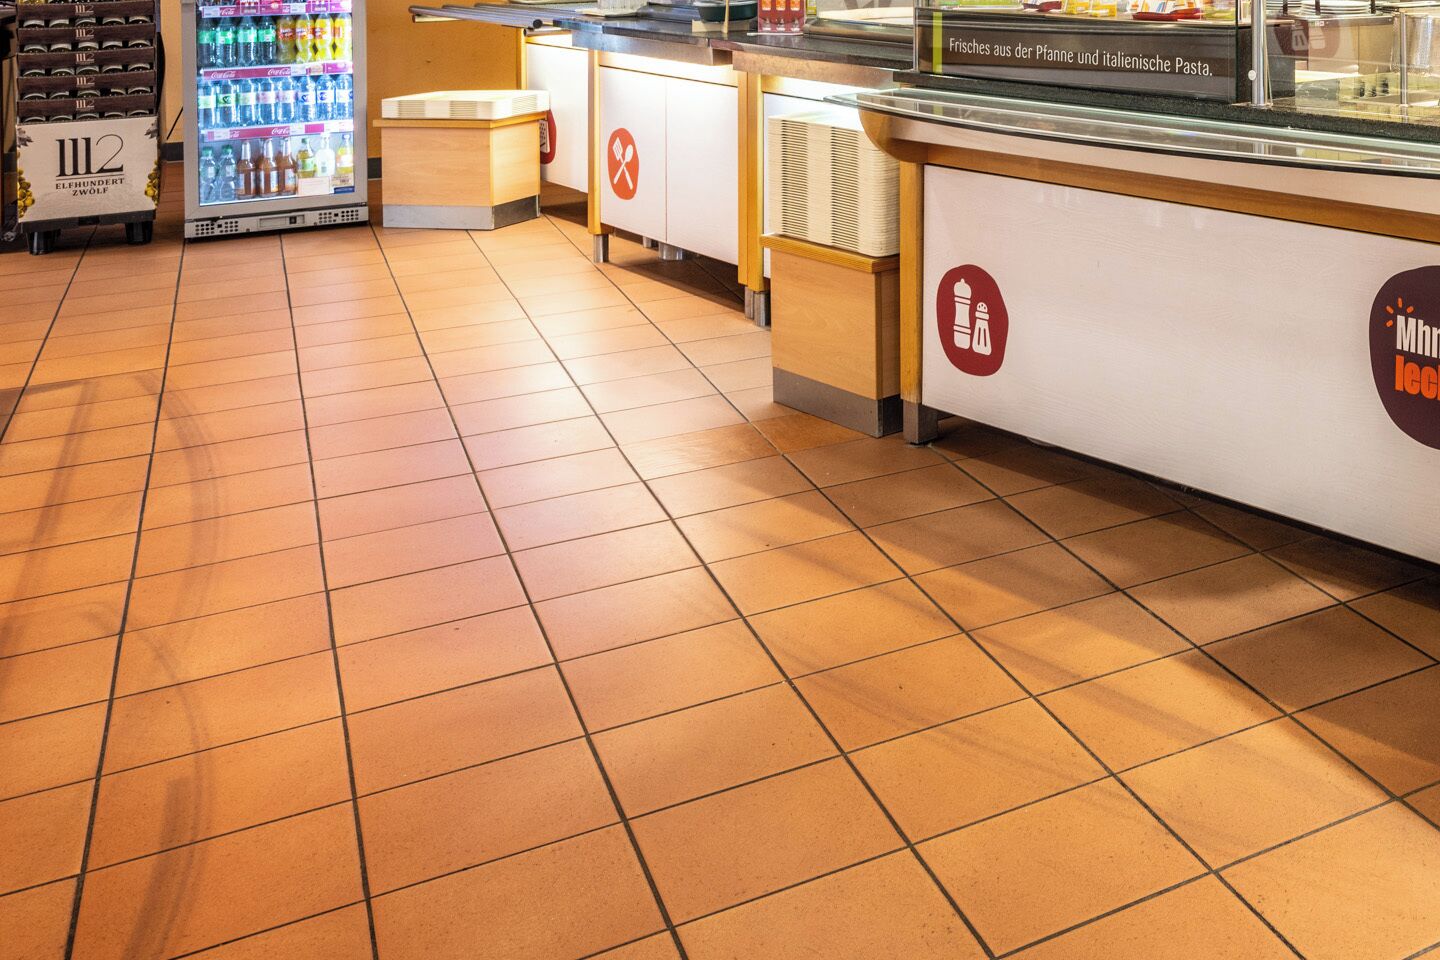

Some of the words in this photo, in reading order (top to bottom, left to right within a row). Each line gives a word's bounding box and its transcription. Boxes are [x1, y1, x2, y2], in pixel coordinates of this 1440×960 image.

[950, 38, 990, 56] Frisches
[994, 44, 1012, 57] aus
[1015, 42, 1033, 59] der
[1036, 44, 1074, 63] Pfanne
[1078, 49, 1099, 66] und
[1103, 51, 1171, 72] italienische
[1176, 57, 1213, 76] Pasta.
[56, 178, 125, 190] ELFHUNDERT
[72, 187, 109, 197] ZWÖLF
